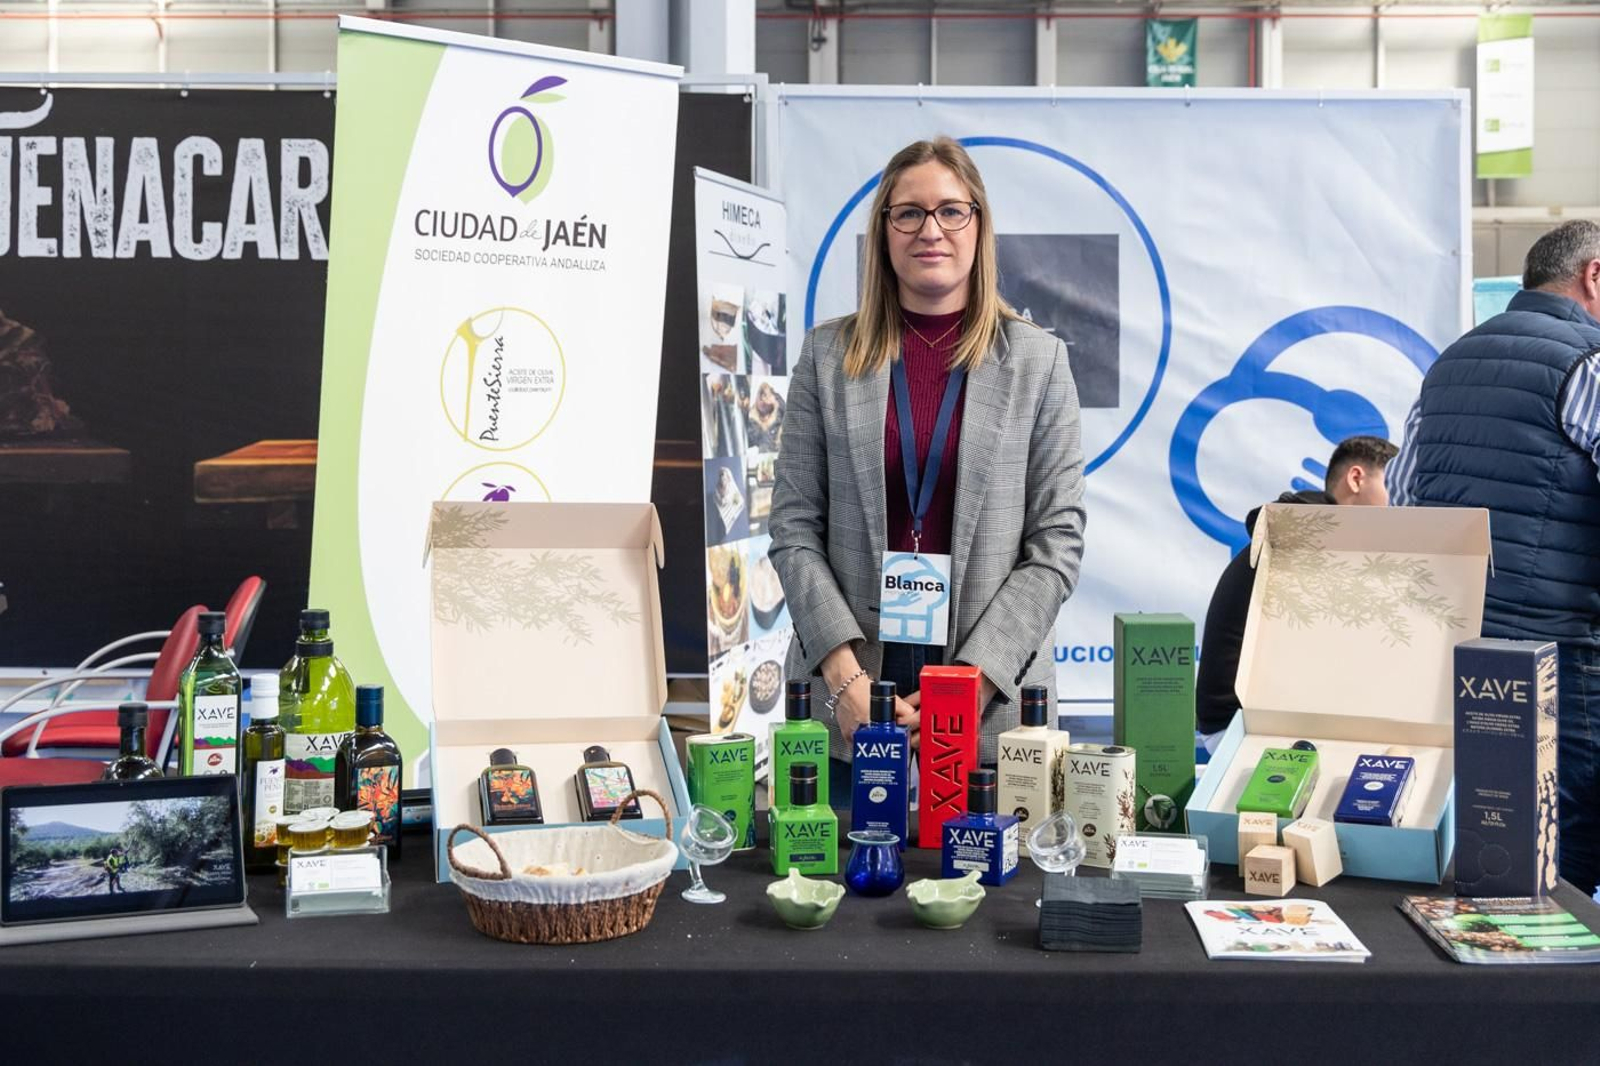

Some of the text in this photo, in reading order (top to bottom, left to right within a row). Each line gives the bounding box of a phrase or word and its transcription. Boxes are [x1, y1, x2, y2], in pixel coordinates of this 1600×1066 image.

[722, 200, 761, 229] HIMECA
[414, 209, 607, 252] CIUDAD de JAÉN
[414, 248, 606, 271] SOCIEDAD COOPERATIVA ANDALUZA
[479, 336, 504, 441] PuenteSierra
[506, 376, 555, 384] VIRGEN EXTRA
[885, 575, 945, 593] Blanca
[1131, 647, 1191, 666] XAVE
[1459, 676, 1528, 703] XAVE
[198, 707, 235, 720] XAVE
[710, 748, 748, 765] XAVE
[781, 740, 824, 756] XAVE
[856, 742, 903, 759] XAVE
[1001, 745, 1042, 764] XAVE
[931, 713, 963, 813] XAVE
[1264, 751, 1309, 763] XAVE
[1359, 758, 1409, 770] XAVE
[1070, 760, 1112, 777] XAVE
[785, 822, 832, 838] XAVE
[1243, 818, 1273, 826] XAVE
[949, 828, 997, 848] XAVE
[1121, 840, 1150, 848] XAVE
[297, 860, 326, 869] XAVE
[1249, 870, 1281, 884] XAVE
[1237, 926, 1319, 937] XAVE
